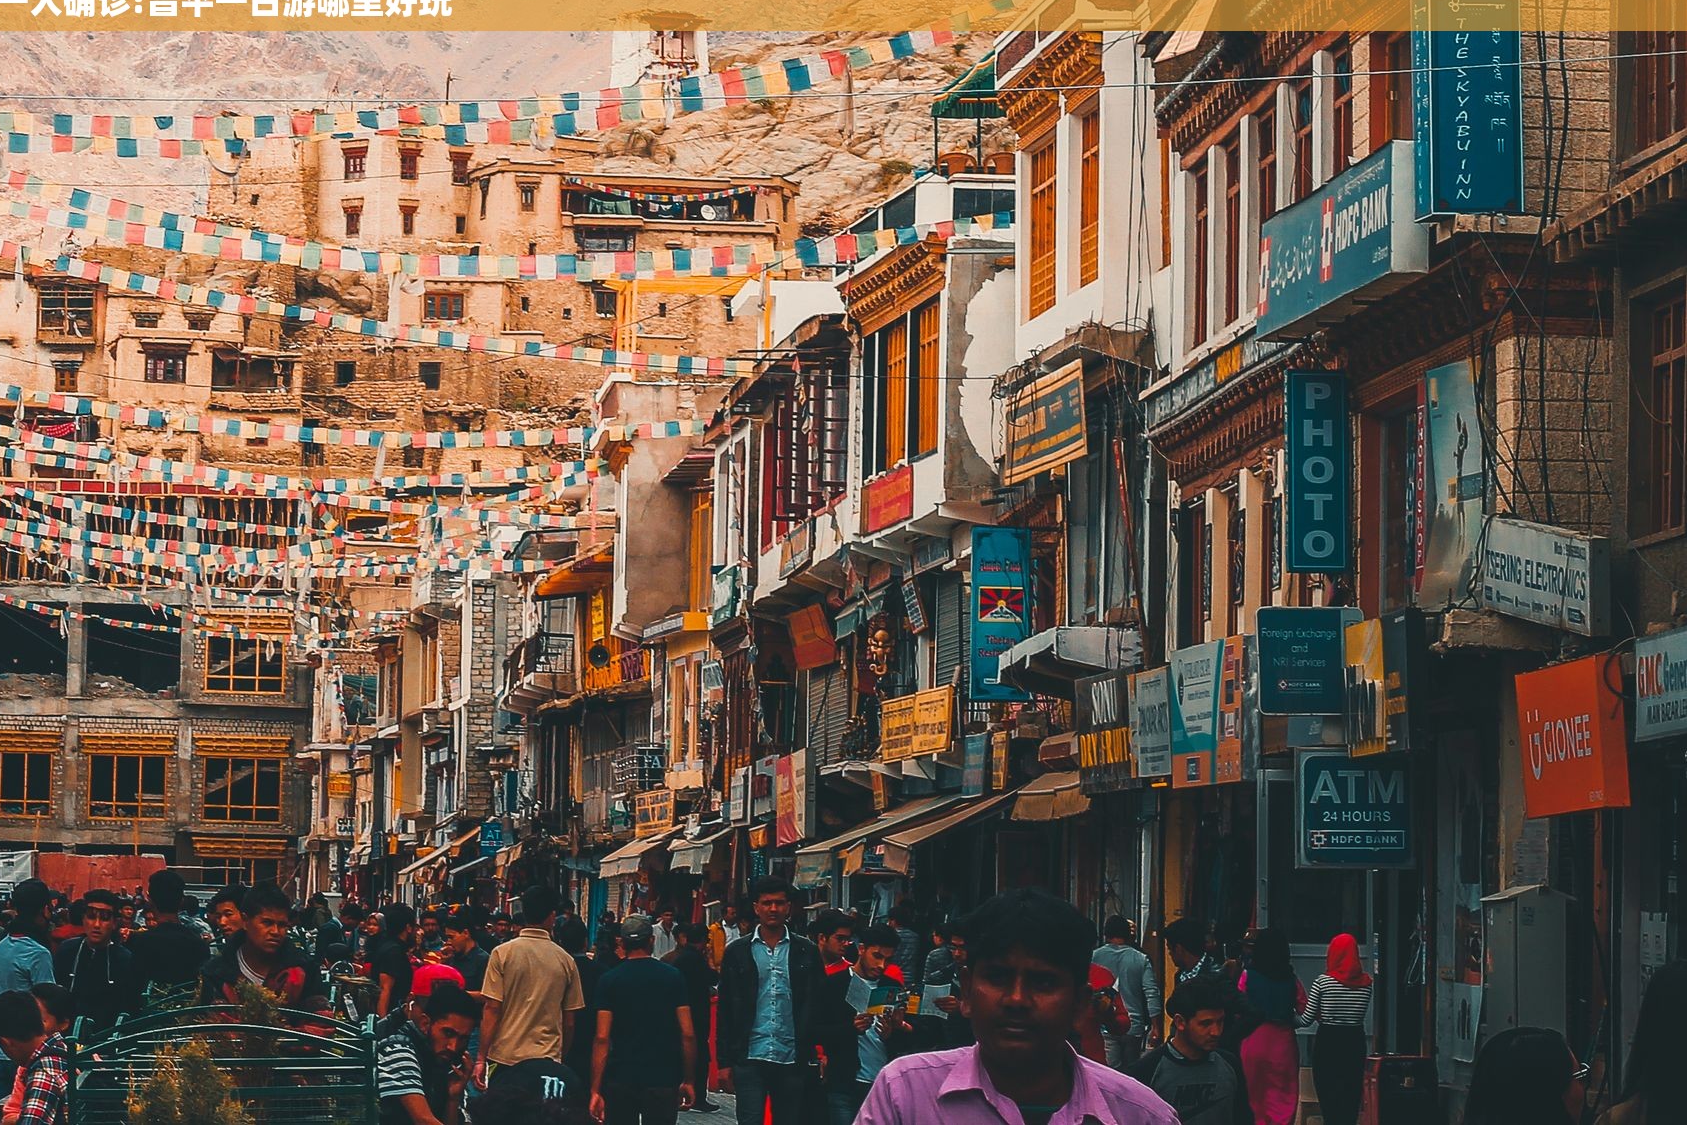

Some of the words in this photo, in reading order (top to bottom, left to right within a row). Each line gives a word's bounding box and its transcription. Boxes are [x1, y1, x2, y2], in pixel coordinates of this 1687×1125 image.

[1455, 18, 1469, 59] THE
[1456, 159, 1472, 200] INN
[1335, 201, 1360, 254] HDFC
[1361, 184, 1389, 239] BANK
[1302, 382, 1335, 559] PHOTO
[1417, 411, 1426, 491] PHOTO
[1416, 499, 1424, 563] SHOP
[1485, 549, 1521, 585] TSERING
[1524, 559, 1586, 601] ELECTRONICS
[1261, 628, 1294, 642] Foreign
[1296, 627, 1337, 642] Exchange
[1291, 643, 1308, 653] and
[1292, 658, 1326, 667] Services
[1079, 733, 1098, 768] DRY
[1543, 714, 1592, 763] GIONEE
[1310, 770, 1404, 803] ATM
[1323, 811, 1338, 821] 24
[1342, 811, 1391, 822] HOURS
[1331, 835, 1362, 844] HDFC
[1366, 835, 1398, 844] BANK
